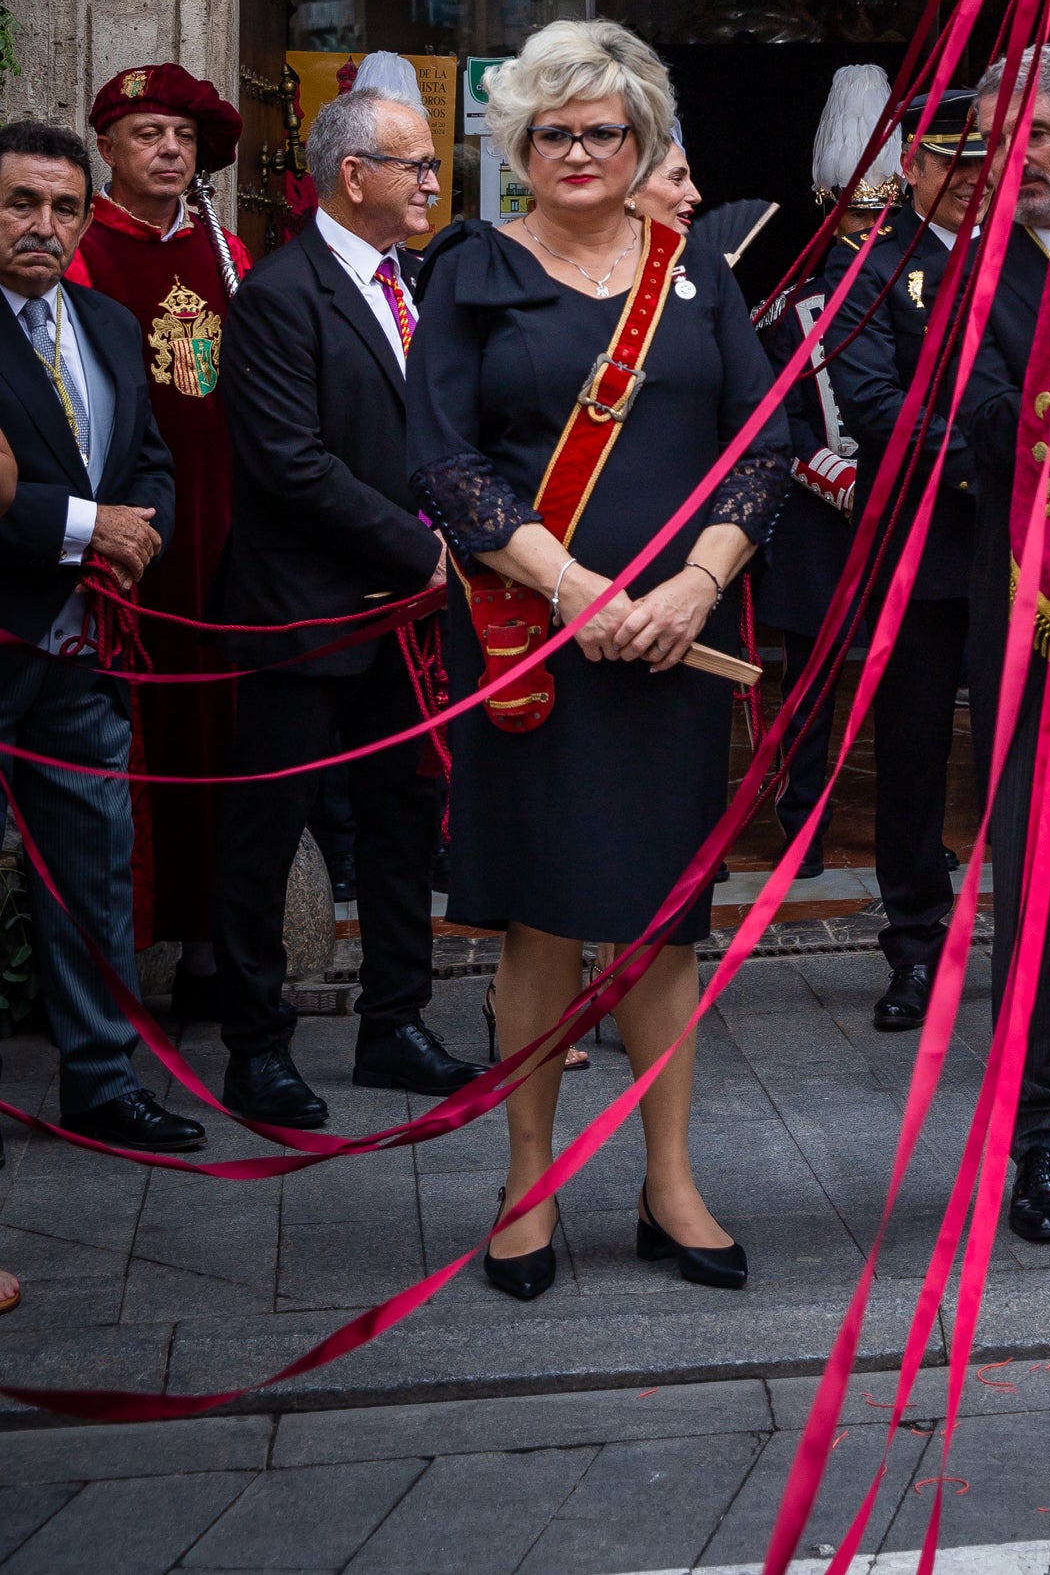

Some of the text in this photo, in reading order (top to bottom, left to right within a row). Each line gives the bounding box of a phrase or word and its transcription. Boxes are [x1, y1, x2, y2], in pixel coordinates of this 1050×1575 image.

[419, 69, 447, 79] DE LA
[420, 82, 446, 93] ISTA
[422, 96, 446, 106] OROS
